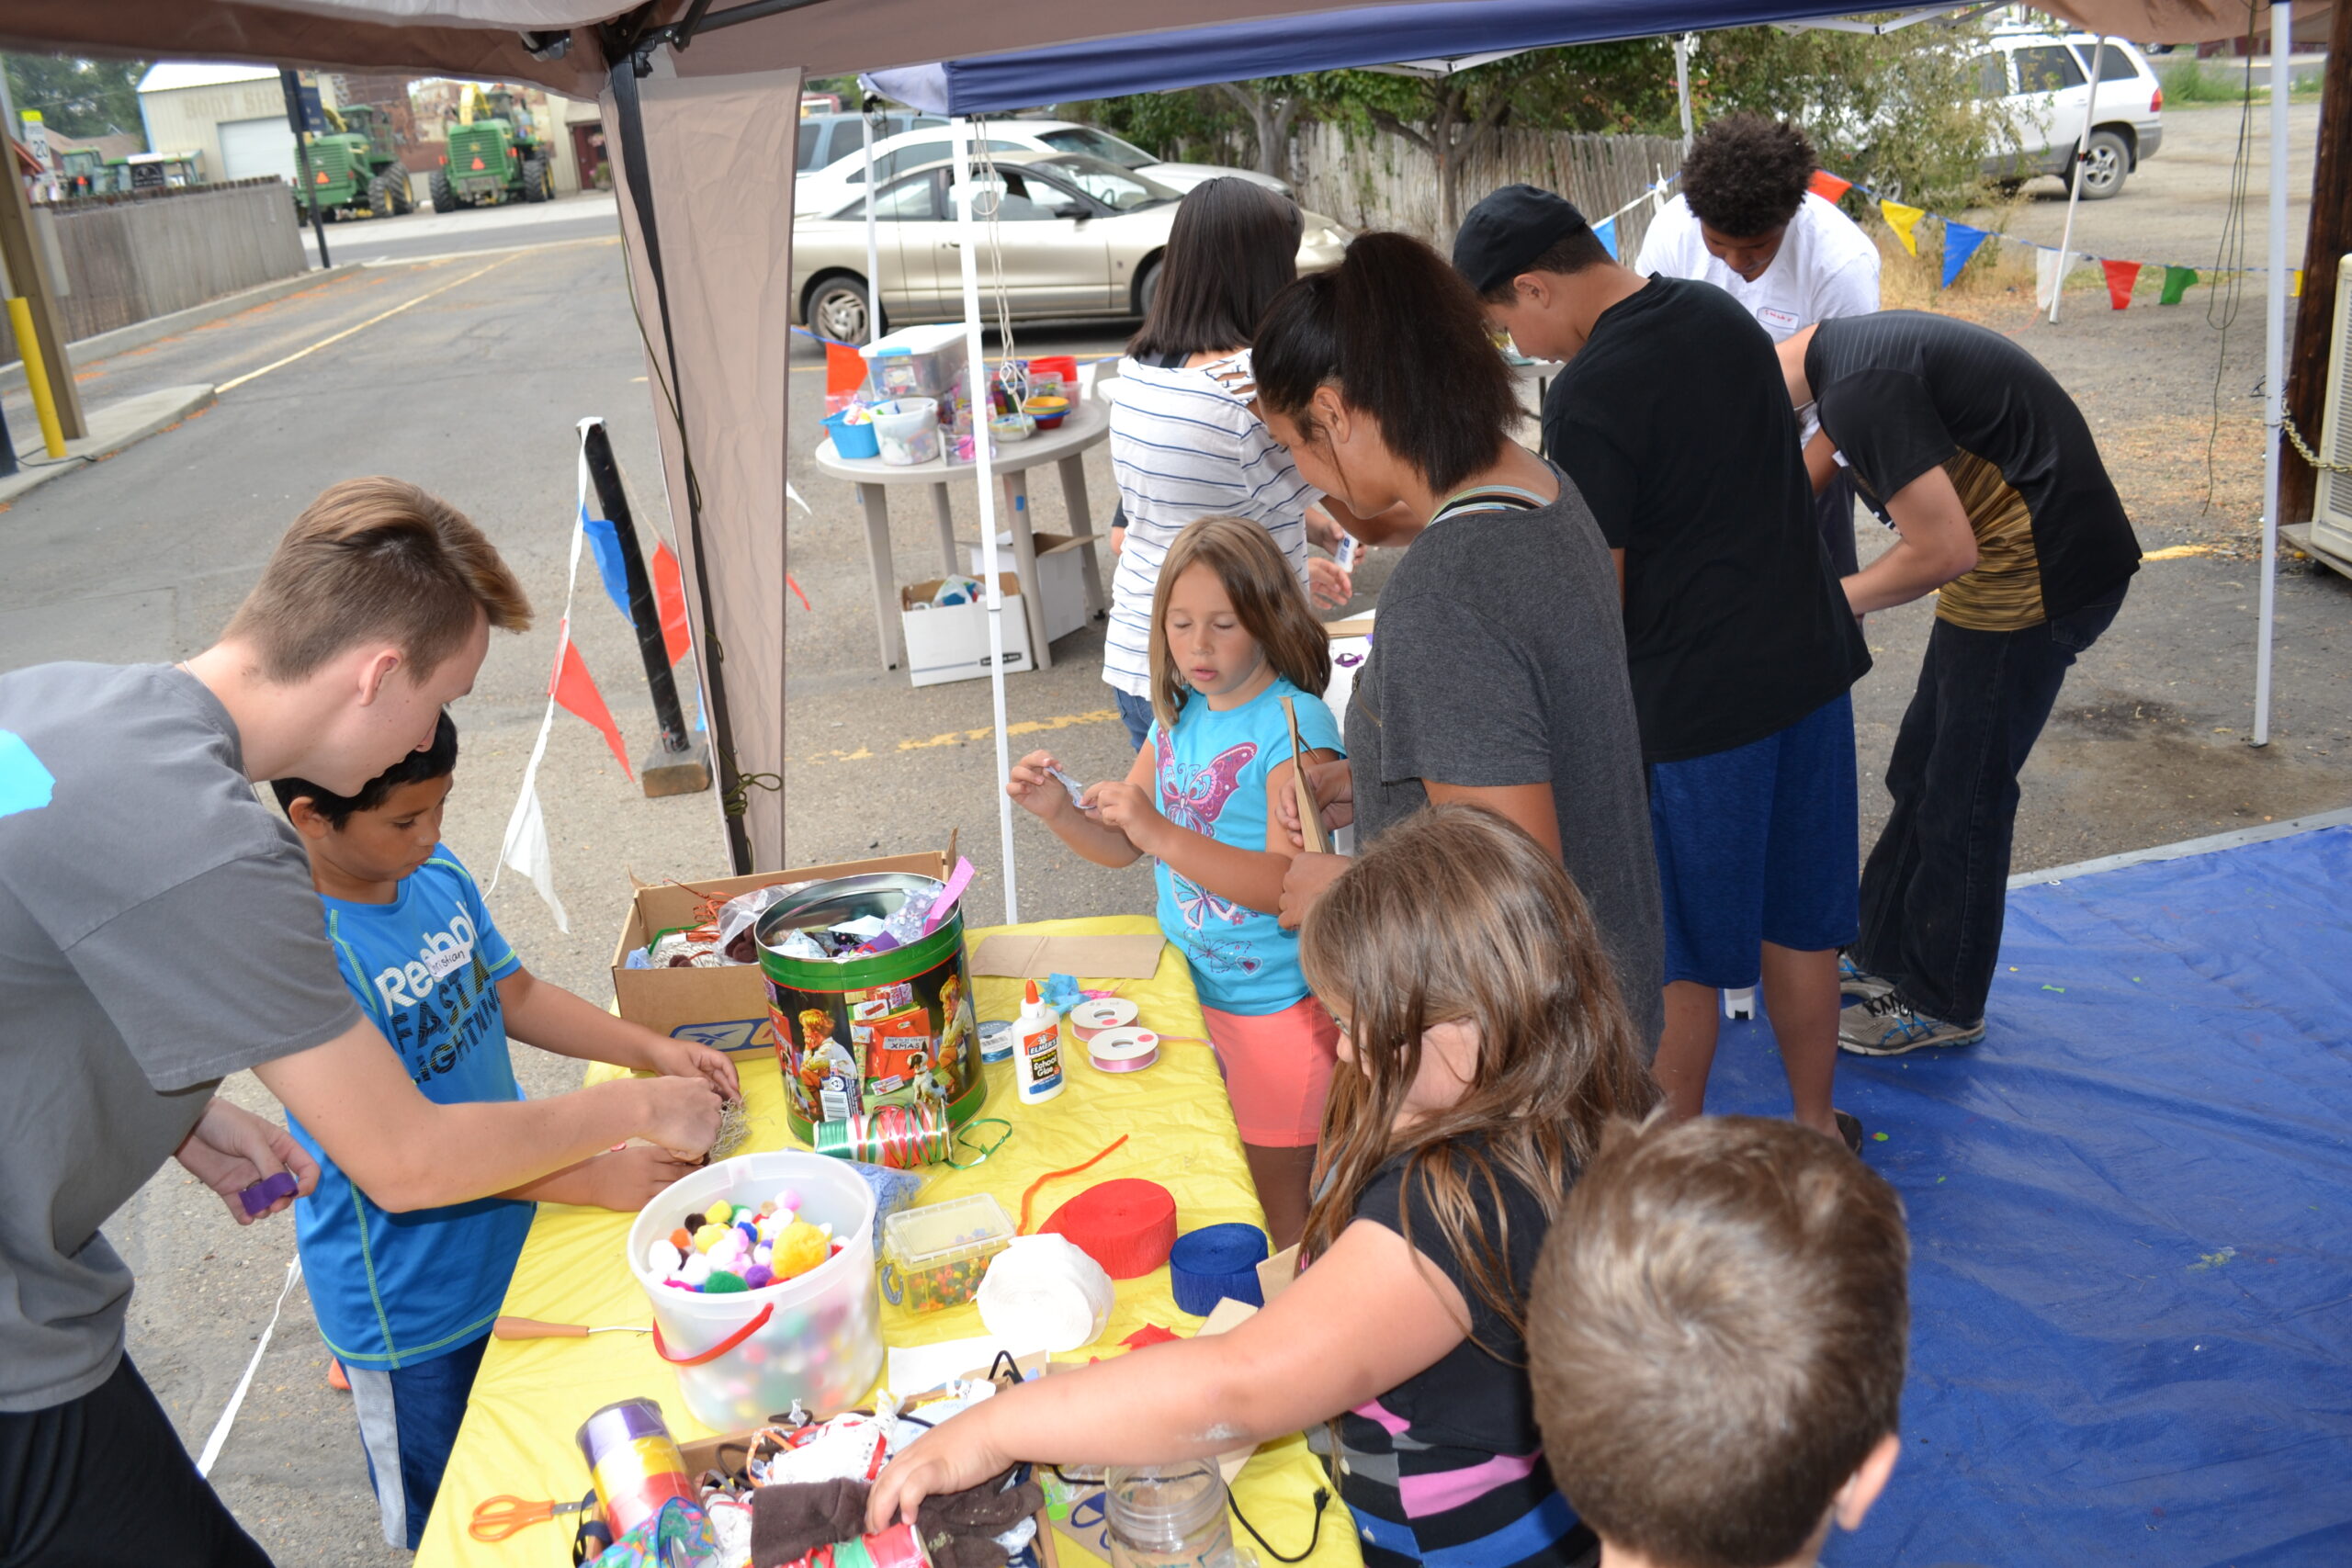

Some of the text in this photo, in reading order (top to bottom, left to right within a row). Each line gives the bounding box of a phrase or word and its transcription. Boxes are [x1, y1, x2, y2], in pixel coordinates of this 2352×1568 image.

[184, 88, 283, 118] BODY SHO
[33, 140, 50, 159] 20
[1034, 1055, 1057, 1071] School
[1036, 1066, 1054, 1077] Glue
